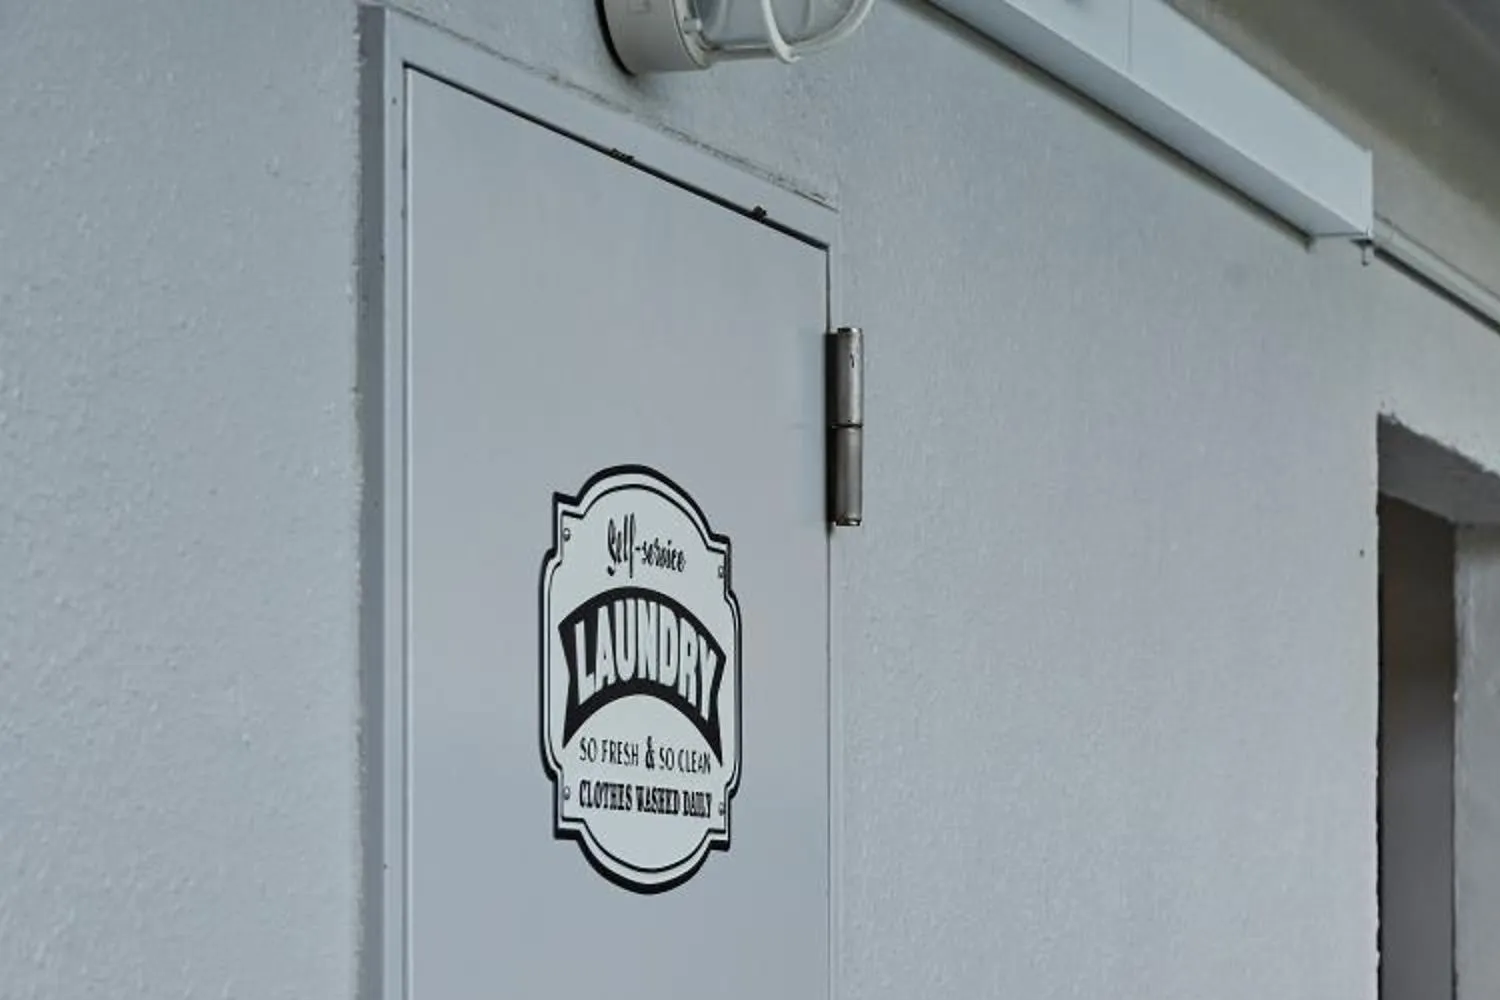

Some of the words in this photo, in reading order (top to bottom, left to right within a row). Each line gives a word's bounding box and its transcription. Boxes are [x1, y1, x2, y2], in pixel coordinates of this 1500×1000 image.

[574, 597, 718, 722] LAUNDRY
[579, 737, 597, 763] SO
[601, 739, 639, 767] FRESH
[645, 736, 655, 769] &
[660, 747, 674, 771] SO
[678, 748, 711, 775] CLEAN
[579, 780, 633, 811] CLOTHES
[635, 785, 679, 815] WASHED
[682, 790, 712, 818] DAILY
